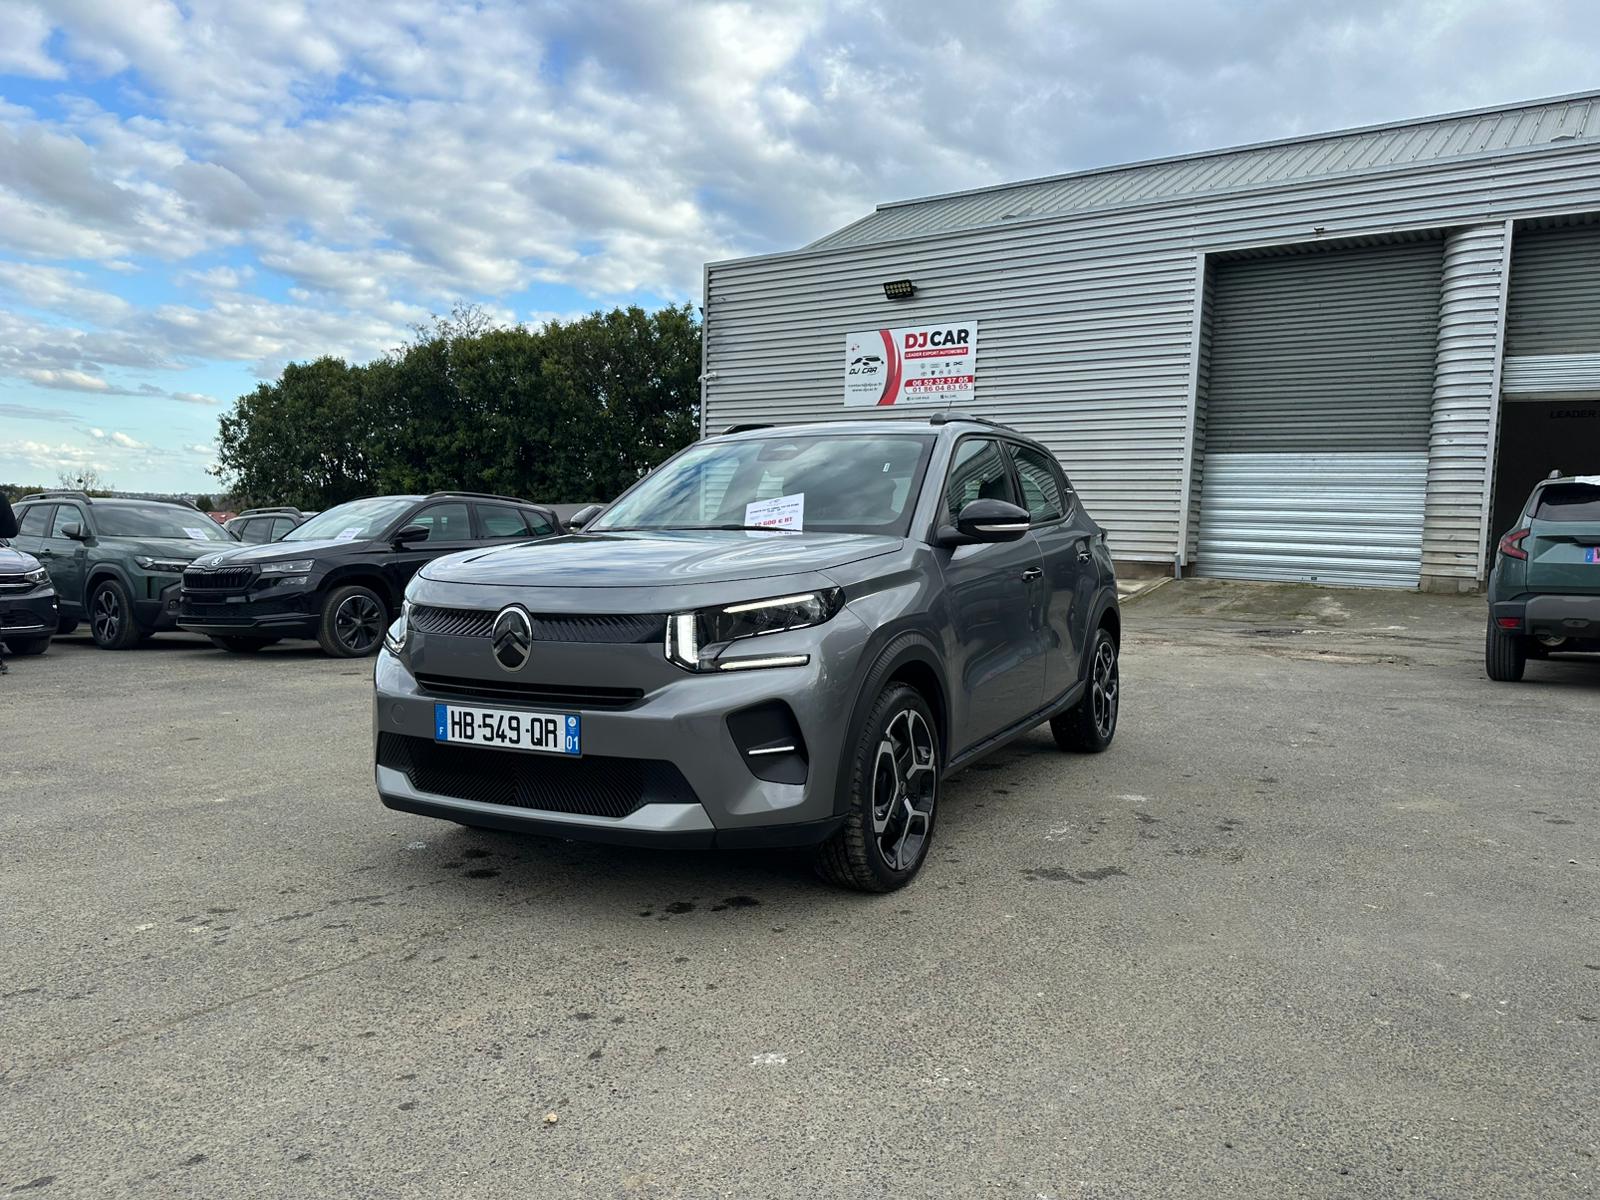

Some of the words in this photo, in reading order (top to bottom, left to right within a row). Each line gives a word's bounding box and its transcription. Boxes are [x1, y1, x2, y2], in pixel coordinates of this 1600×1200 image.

[930, 328, 969, 347] CAR
[861, 366, 878, 374] CAR
[1550, 409, 1597, 419] LEADER
[439, 727, 445, 735] F
[450, 710, 558, 748] HB-549-QR
[566, 735, 579, 750] 01
